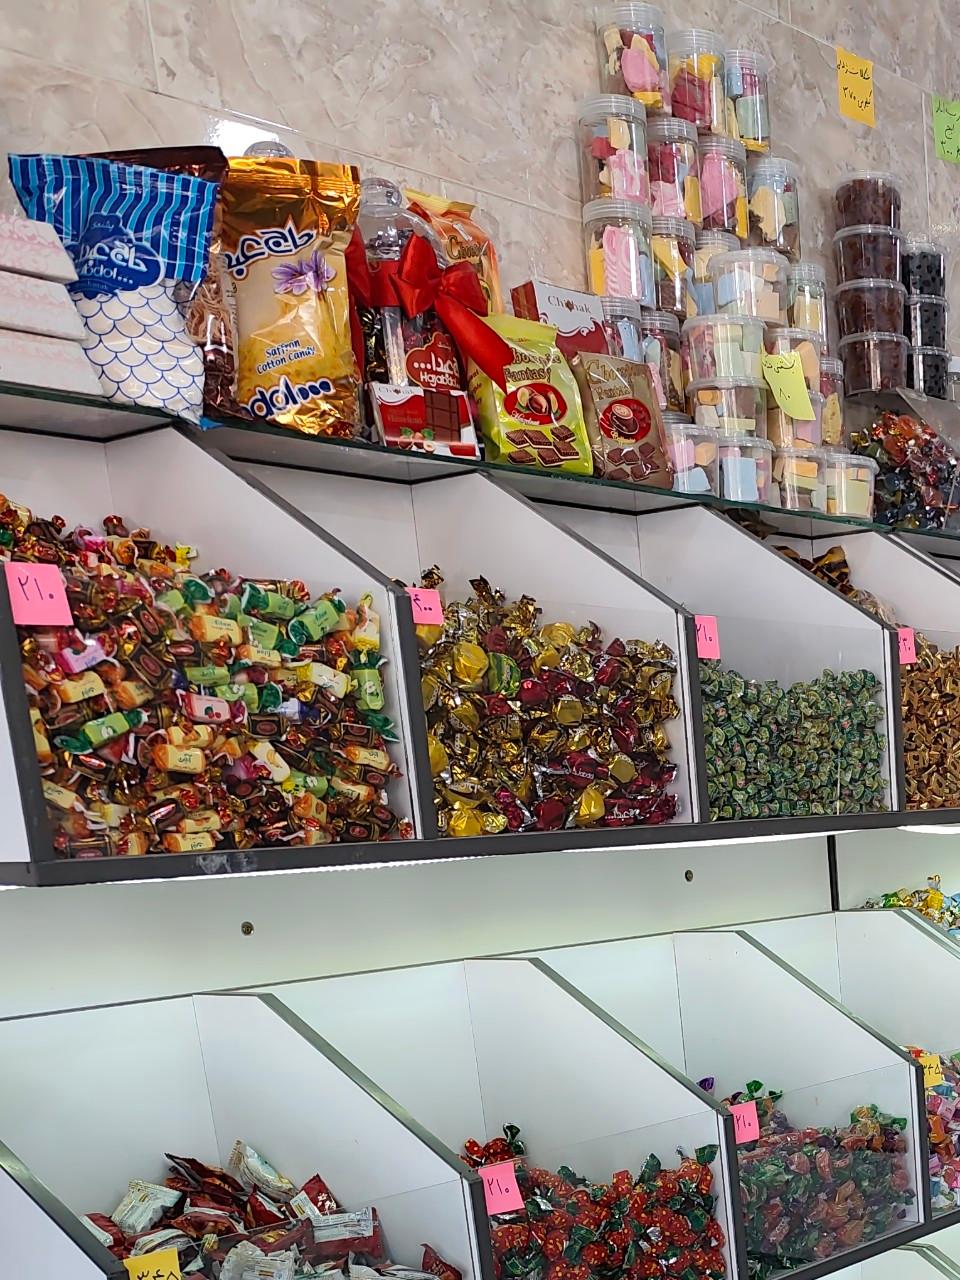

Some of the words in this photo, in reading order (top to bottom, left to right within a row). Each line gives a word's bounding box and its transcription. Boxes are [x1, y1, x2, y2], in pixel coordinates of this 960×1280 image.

[265, 339, 301, 359] Saffron
[256, 358, 287, 375] Cotton
[288, 346, 316, 362] Candy
[17, 576, 55, 601] ۲۱۰
[735, 1114, 753, 1131] ۲۱۰
[486, 1177, 511, 1197] ۲۱۰
